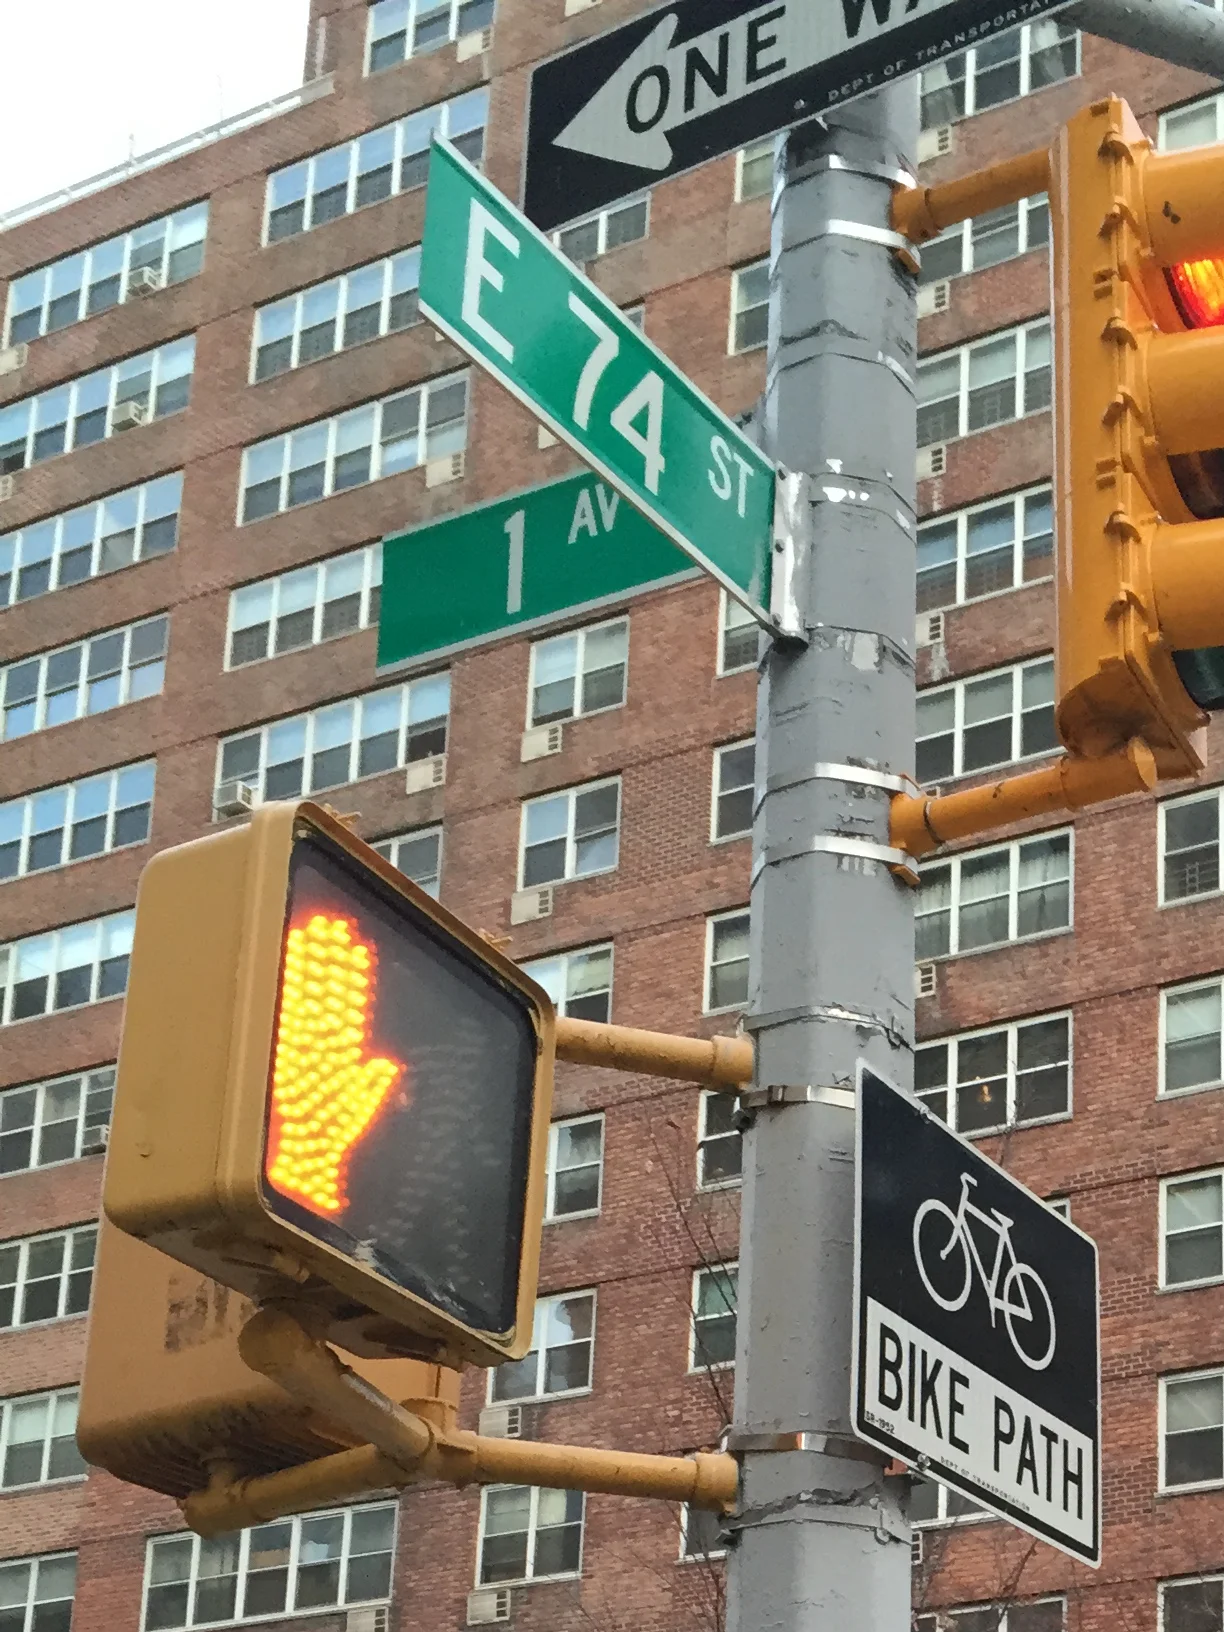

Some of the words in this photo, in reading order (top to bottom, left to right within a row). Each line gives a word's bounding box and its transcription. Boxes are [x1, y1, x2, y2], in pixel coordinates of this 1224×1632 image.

[625, 5, 786, 134] ONE
[827, 72, 874, 102] DEPT
[883, 59, 907, 76] OF
[917, 0, 1050, 61] TRANSPORTA
[461, 197, 521, 365] E
[567, 291, 666, 496] 74
[707, 435, 754, 518] ST
[503, 508, 526, 614] 1
[567, 483, 620, 545] AV
[878, 1321, 970, 1455] BIKE
[993, 1394, 1084, 1520] PATH
